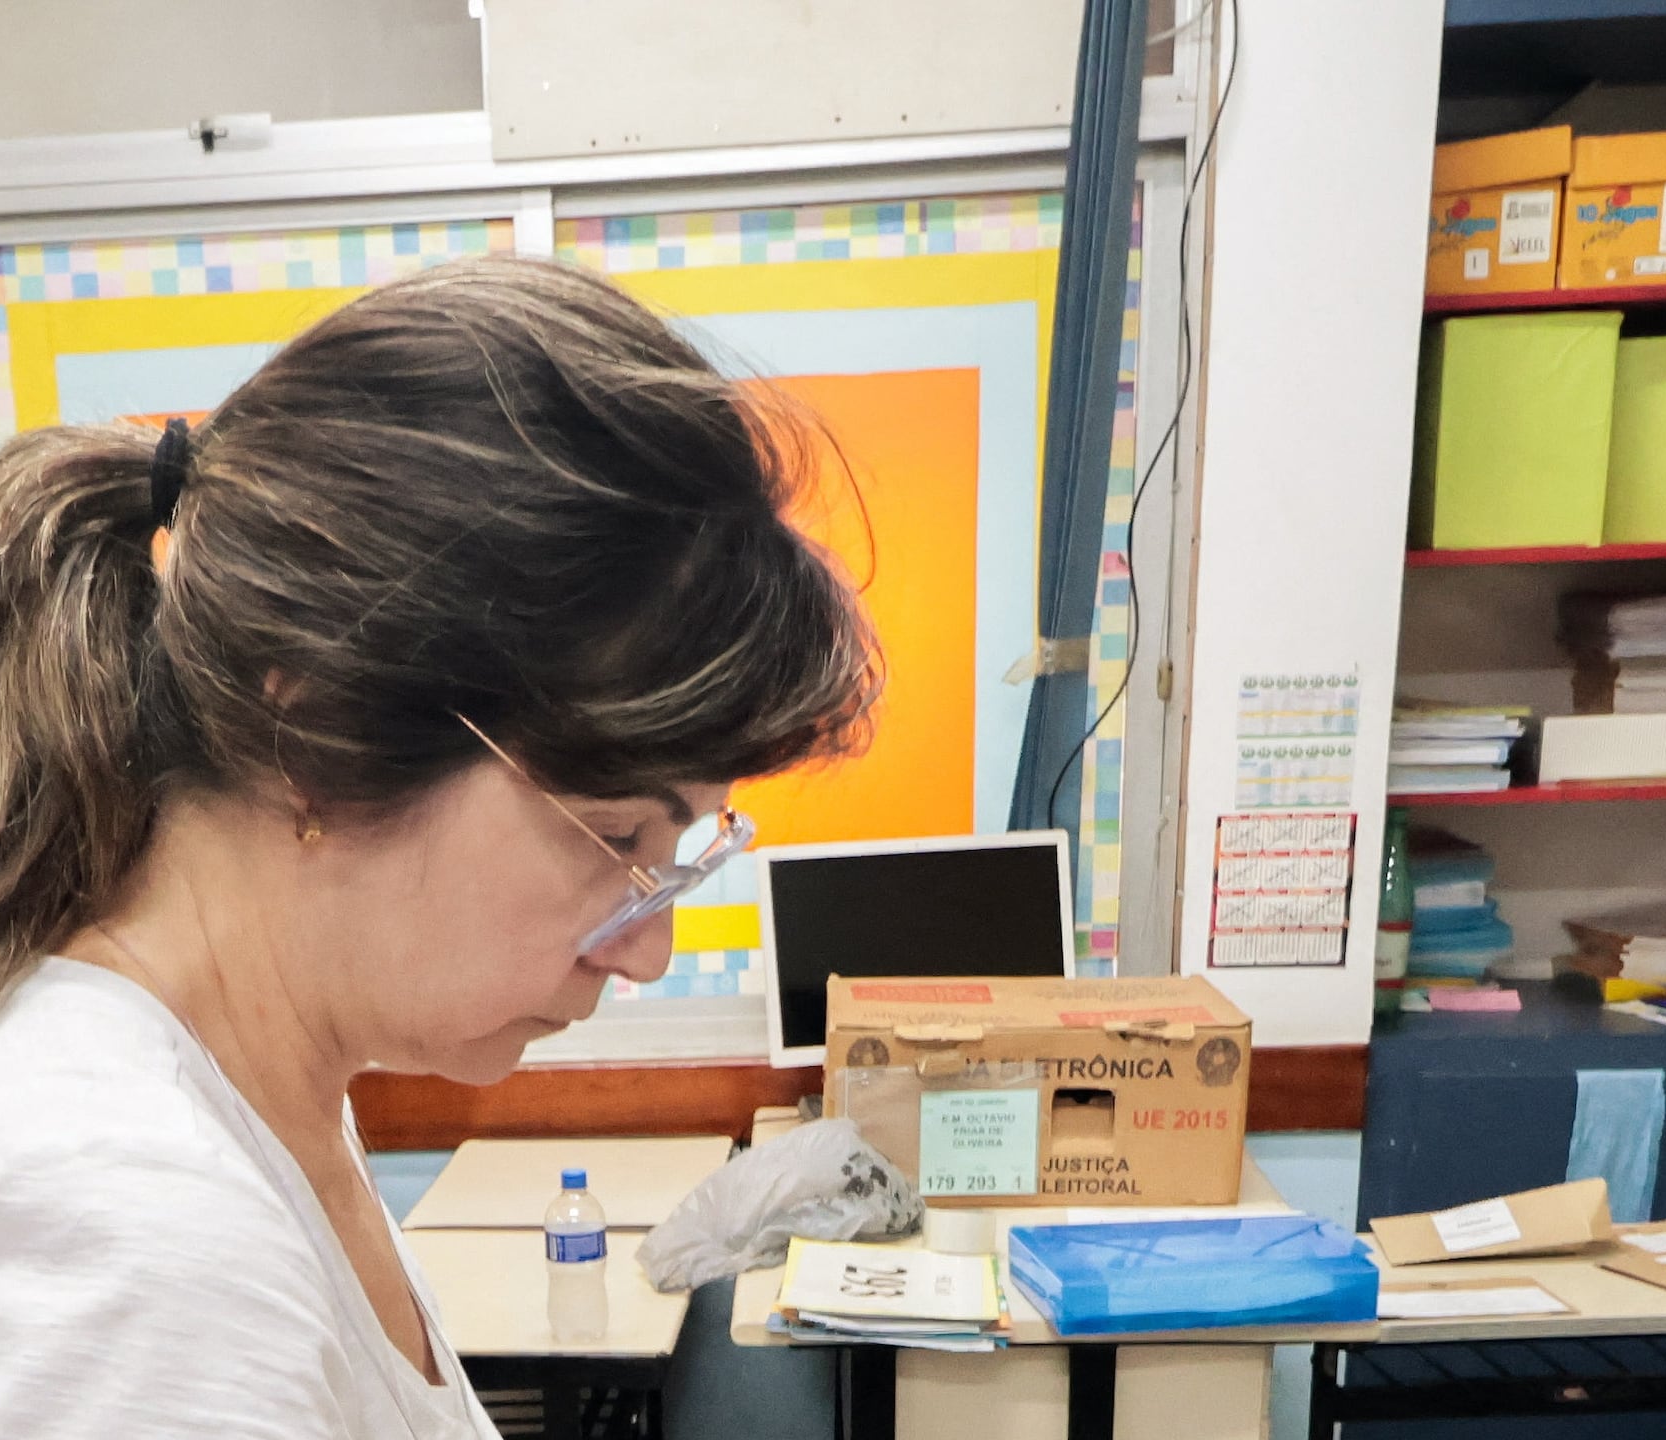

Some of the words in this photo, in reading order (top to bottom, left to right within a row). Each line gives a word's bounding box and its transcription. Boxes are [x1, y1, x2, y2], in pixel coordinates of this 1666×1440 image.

[1134, 1110, 1165, 1130] UE
[1174, 1109, 1229, 1130] 2015
[1043, 1157, 1130, 1175] JUSTIÇA
[927, 1175, 955, 1191] 179
[967, 1175, 997, 1191] 293
[1041, 1179, 1142, 1195] LEITORAL
